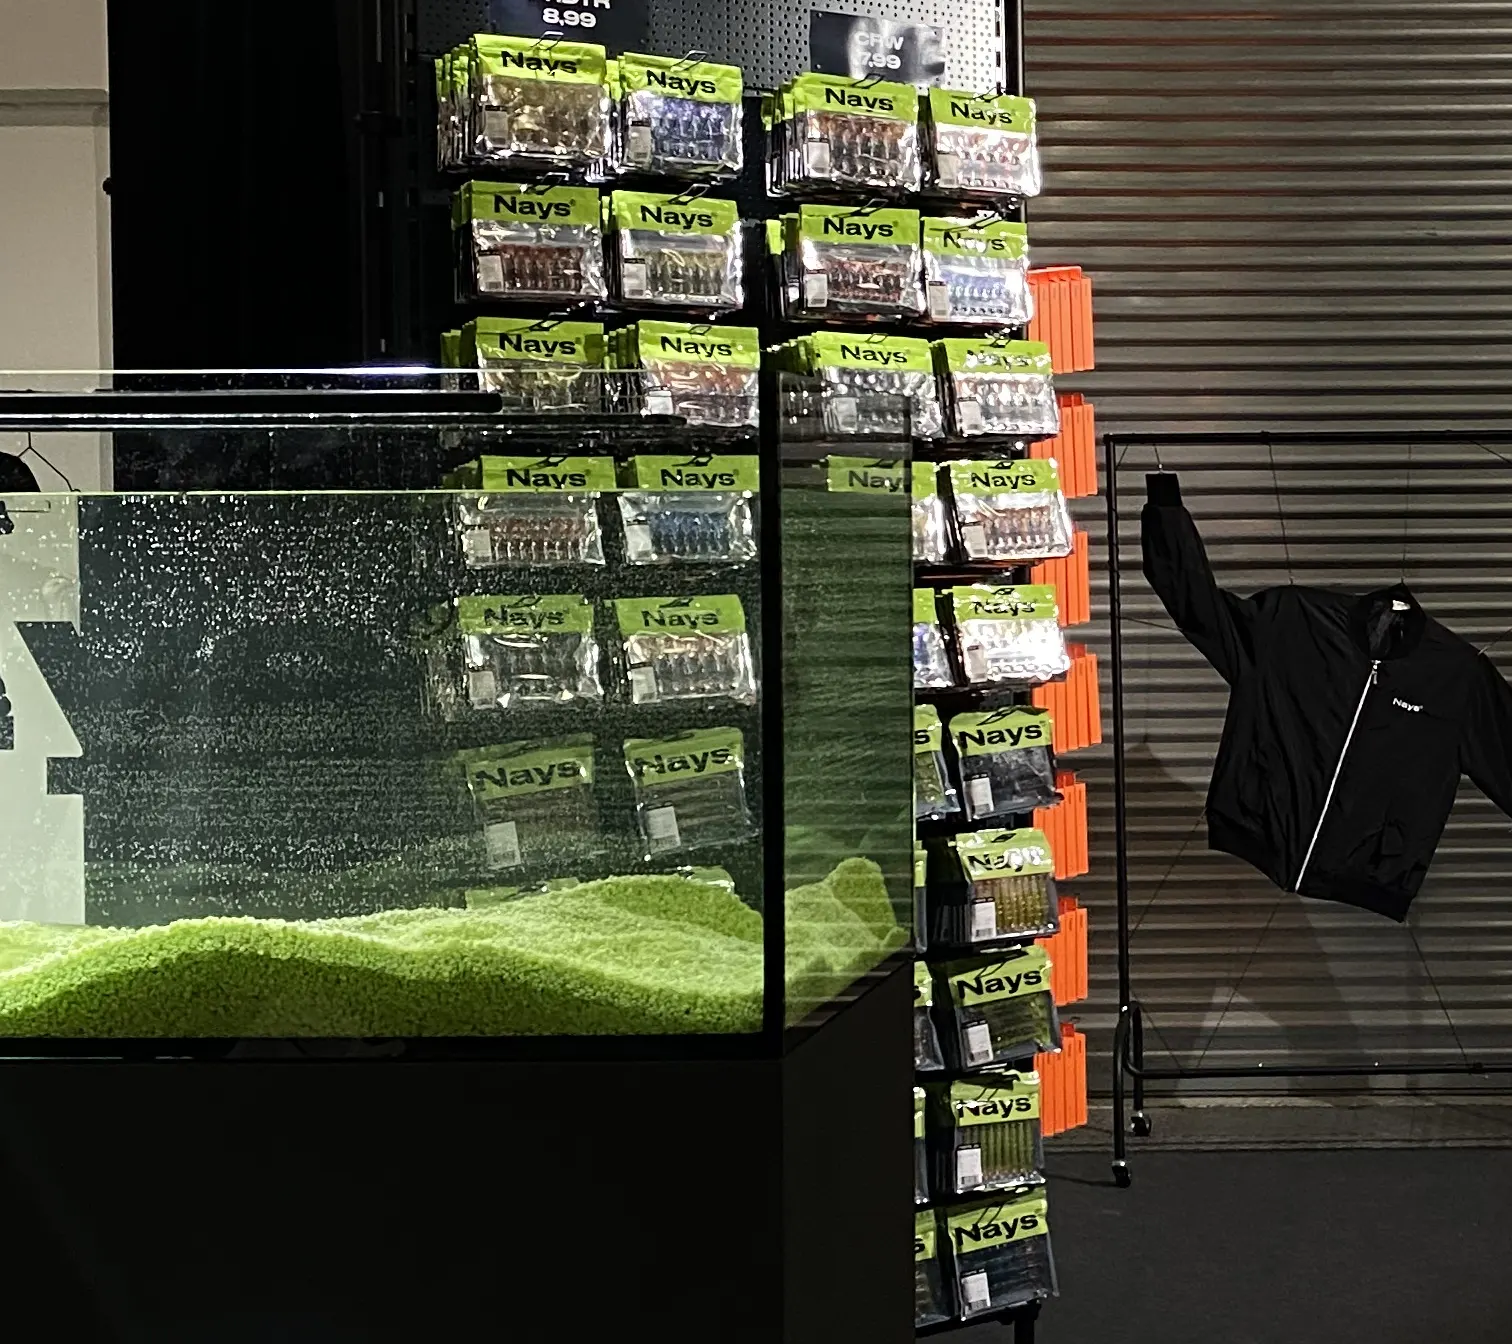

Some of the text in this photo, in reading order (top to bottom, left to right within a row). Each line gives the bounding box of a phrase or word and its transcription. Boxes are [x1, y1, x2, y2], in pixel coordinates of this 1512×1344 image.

[542, 7, 597, 28] 8,99
[501, 51, 577, 75] Nays
[646, 69, 716, 94] Nays
[825, 88, 894, 112] Nays
[950, 101, 1013, 125] Nays
[493, 195, 571, 217] Nays
[640, 205, 714, 229] Nays
[823, 218, 893, 239] Nays
[943, 231, 1005, 254] Ns
[499, 333, 576, 357] Nays
[660, 336, 732, 357] Nays
[840, 344, 908, 365] Nays
[507, 469, 587, 489] Nays
[660, 469, 735, 488] Nays
[848, 470, 904, 493] Nay
[971, 472, 1036, 490] Nays
[641, 609, 719, 628] Nays
[960, 723, 1044, 748] Nays
[632, 747, 732, 775] Nays
[475, 760, 582, 789] Nays
[957, 972, 1043, 1002] Nays
[954, 1212, 1040, 1246] Nays
